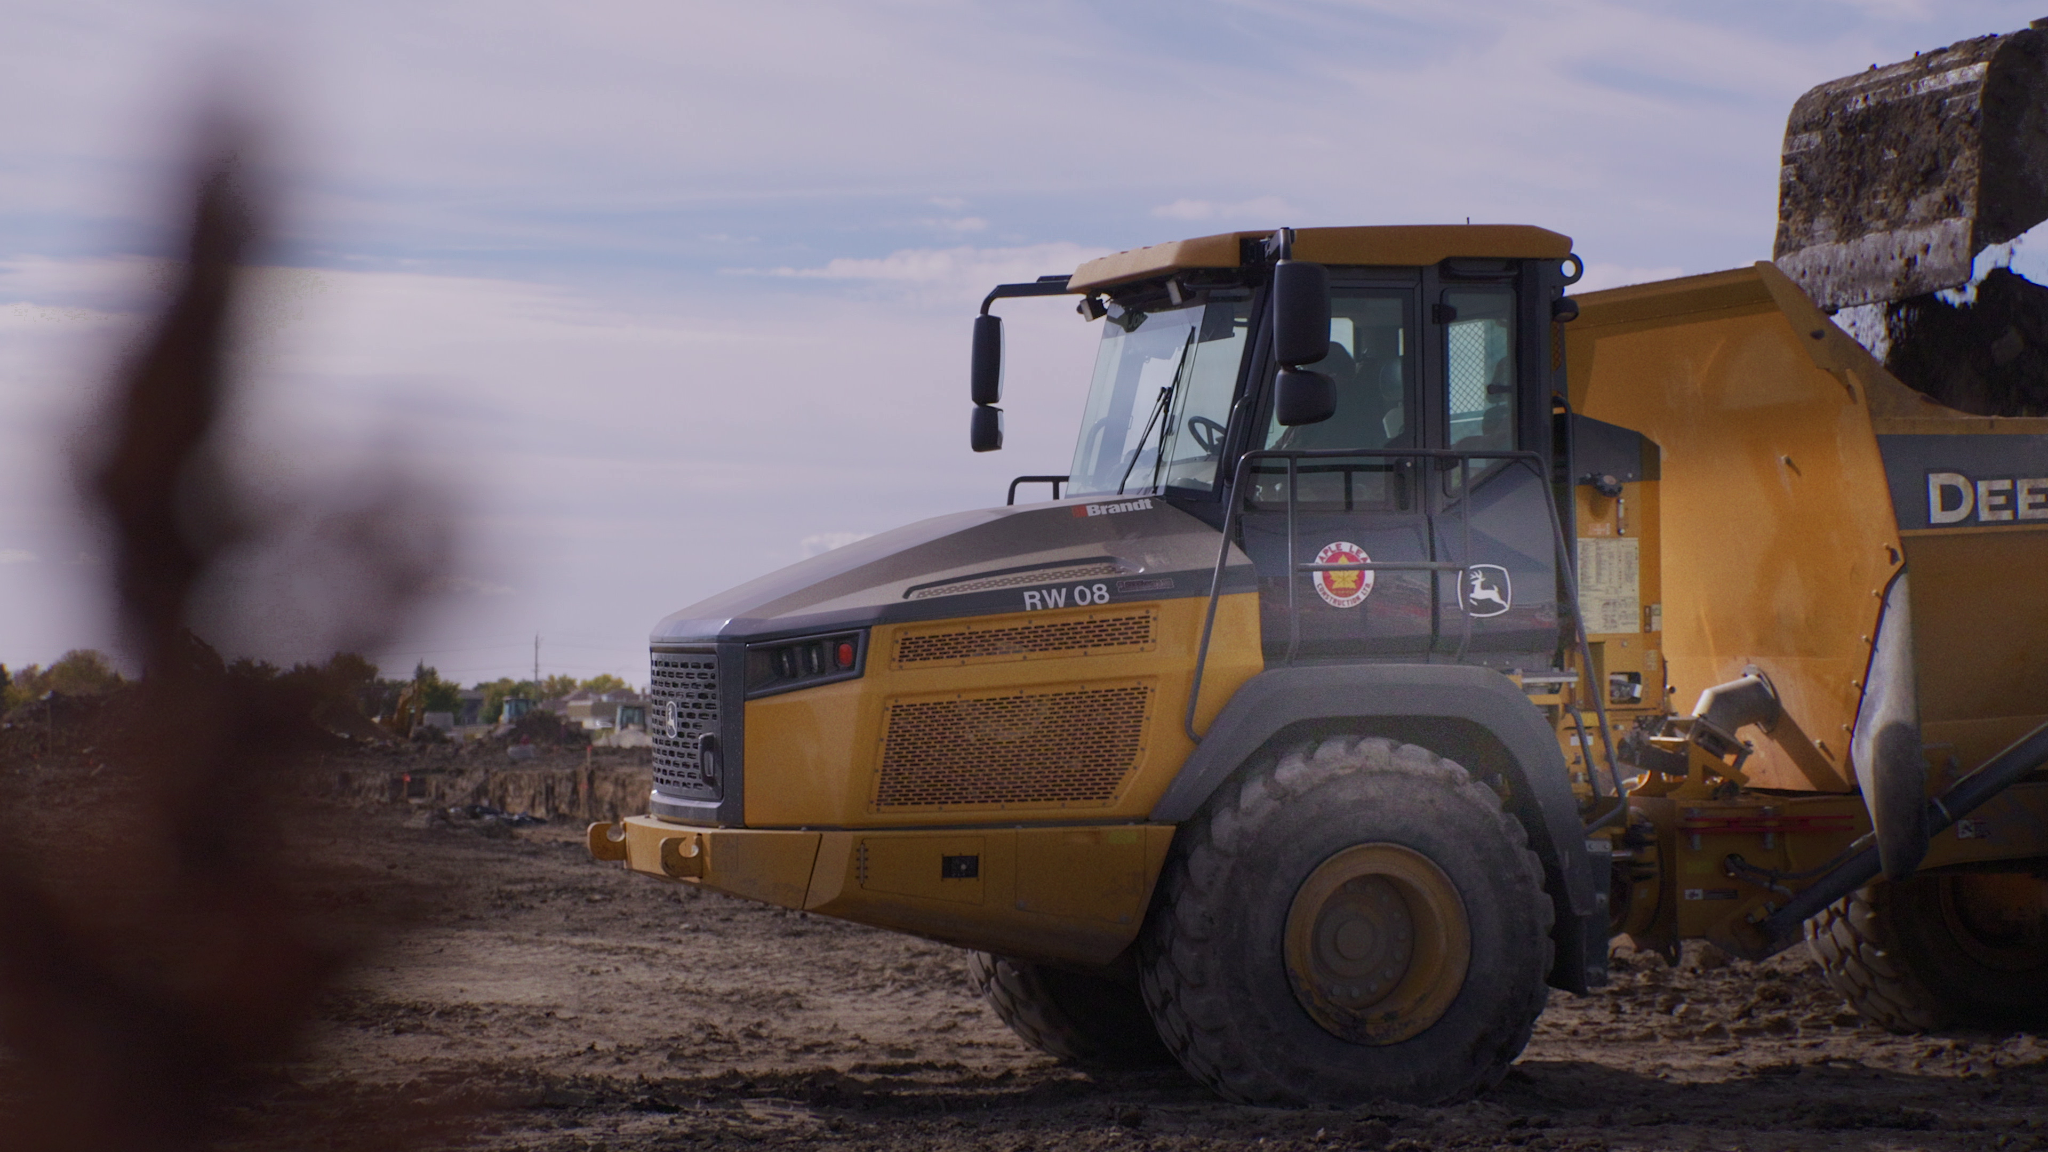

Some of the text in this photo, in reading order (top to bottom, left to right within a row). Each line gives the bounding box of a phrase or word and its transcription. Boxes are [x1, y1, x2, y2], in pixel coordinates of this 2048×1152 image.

[1086, 498, 1154, 517] Brandt
[1316, 543, 1343, 564] APLE
[1023, 588, 1067, 611] RW
[1073, 583, 1110, 606] 08
[1316, 582, 1362, 607] CONSTRUCTION
